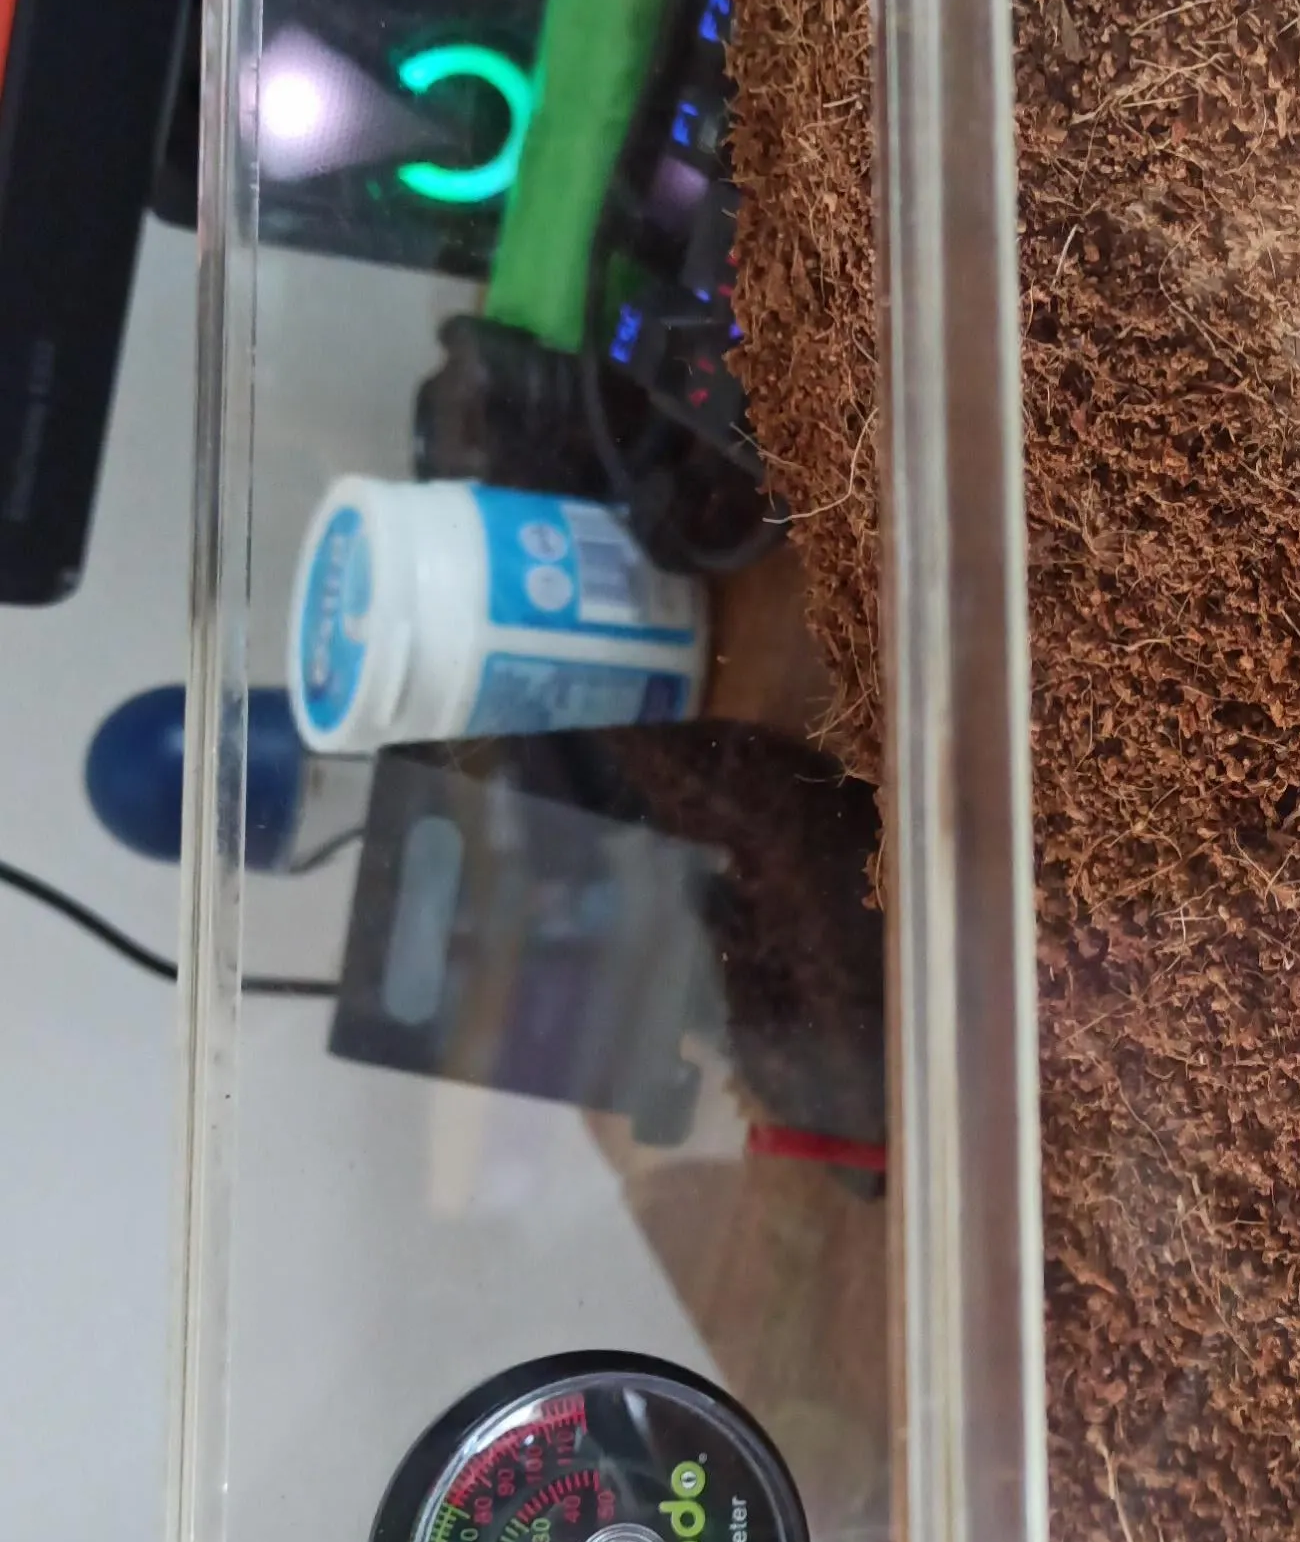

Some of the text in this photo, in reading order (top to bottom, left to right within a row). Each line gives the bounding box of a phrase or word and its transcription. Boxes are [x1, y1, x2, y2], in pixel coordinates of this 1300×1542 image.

[475, 1496, 492, 1525] 80
[498, 1469, 514, 1496] 90
[525, 1446, 542, 1486] 100
[557, 1432, 572, 1466] 110
[564, 1495, 581, 1523] 40
[598, 1490, 614, 1521] 50
